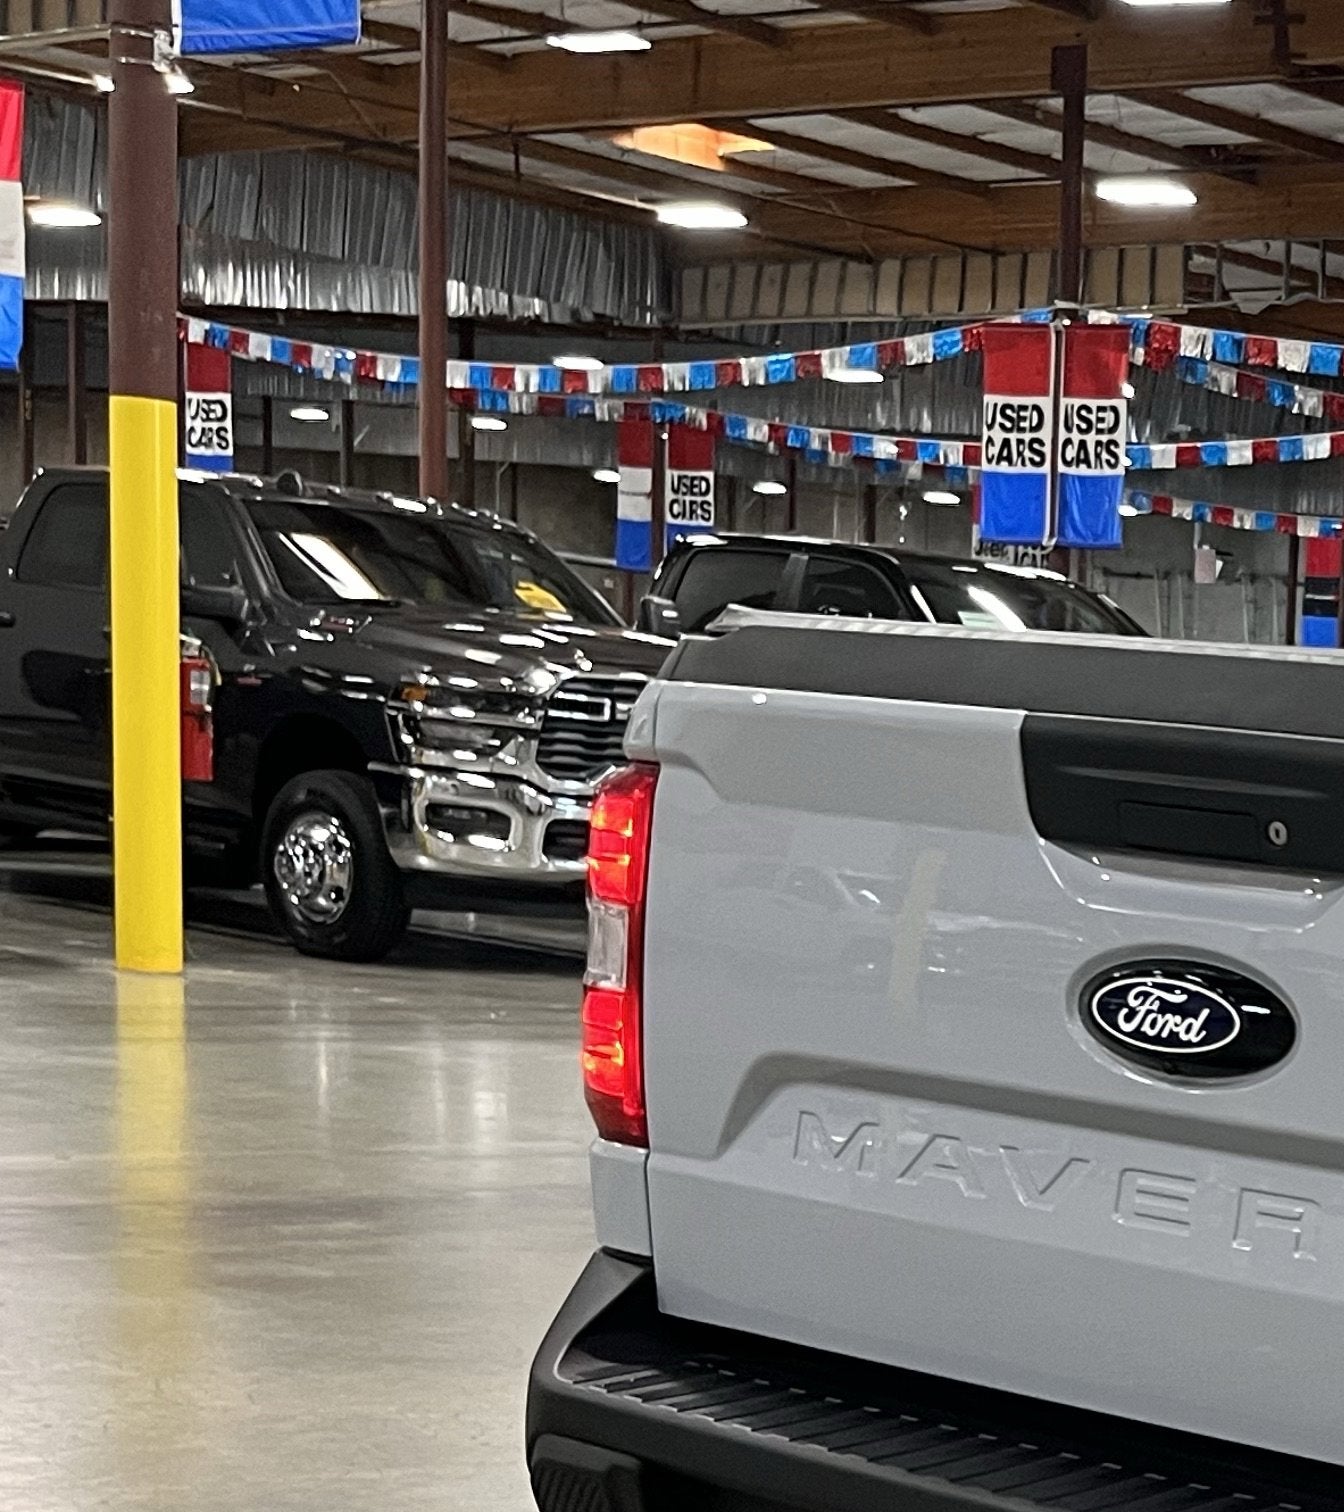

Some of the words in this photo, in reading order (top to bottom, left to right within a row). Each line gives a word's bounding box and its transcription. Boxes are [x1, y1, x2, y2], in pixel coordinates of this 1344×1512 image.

[984, 402, 1045, 434] USED
[1063, 403, 1121, 436] USED
[985, 435, 1046, 468] CARS
[1061, 437, 1121, 470] CARS
[670, 473, 711, 497] USED
[1117, 984, 1212, 1044] Ford
